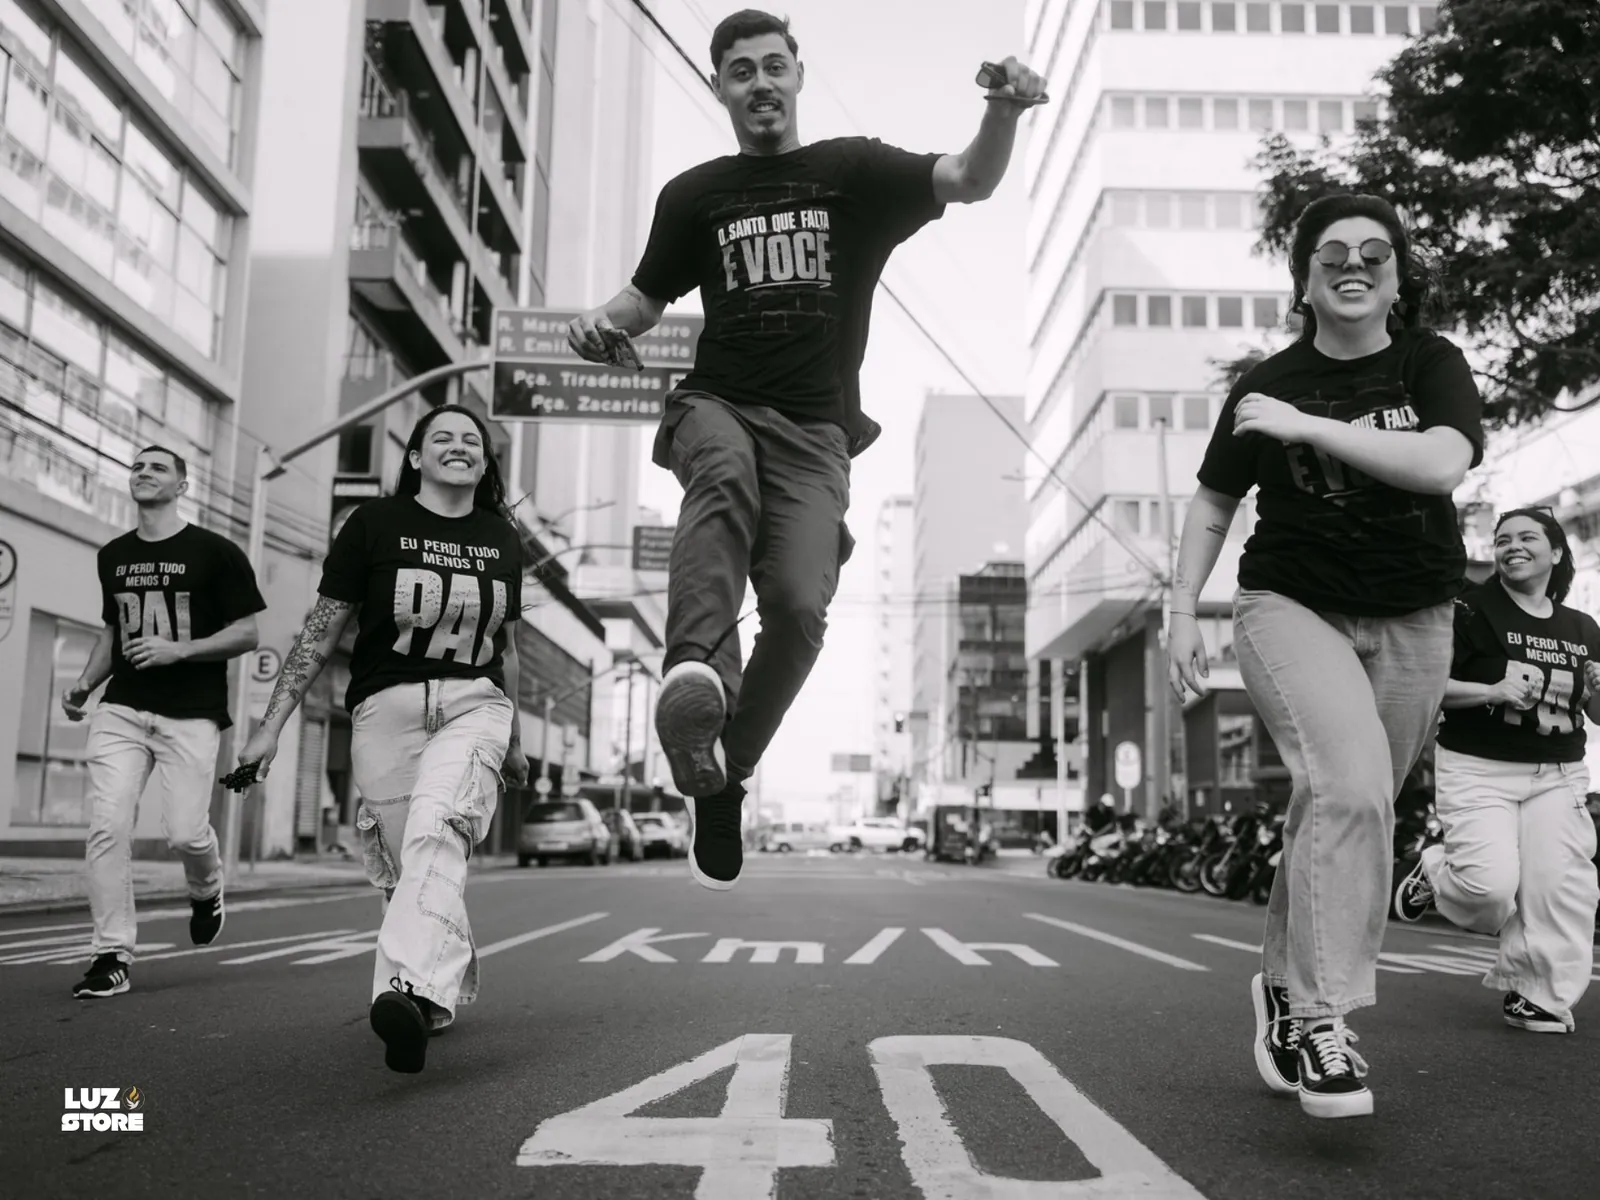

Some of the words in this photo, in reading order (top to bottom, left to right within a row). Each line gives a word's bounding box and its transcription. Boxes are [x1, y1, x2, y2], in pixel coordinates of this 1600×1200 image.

[728, 216, 767, 240] SANTO
[771, 211, 796, 233] QUE
[800, 210, 830, 231] FALTA
[498, 316, 515, 332] R.
[499, 336, 516, 352] R.
[513, 369, 551, 388] Pça.
[560, 371, 662, 390] Tiradentes
[531, 394, 569, 413] Pça.
[577, 395, 661, 414] Zacarias
[400, 537, 418, 550] EU
[424, 539, 461, 556] PERDI
[465, 545, 500, 560] TUDO
[115, 564, 127, 577] EU
[129, 562, 155, 575] PERDI
[159, 562, 186, 575] TUDO
[422, 552, 471, 570] MENOS
[476, 559, 485, 572] O
[125, 575, 160, 588] MENOS
[162, 575, 170, 587] O
[392, 568, 507, 667] PAI
[1507, 631, 1523, 645] EU
[1526, 635, 1559, 651] PERDI
[1561, 640, 1589, 656] TUDO
[1526, 648, 1567, 665] MENOS
[1571, 655, 1578, 668] O
[516, 1033, 1210, 1200] 40
